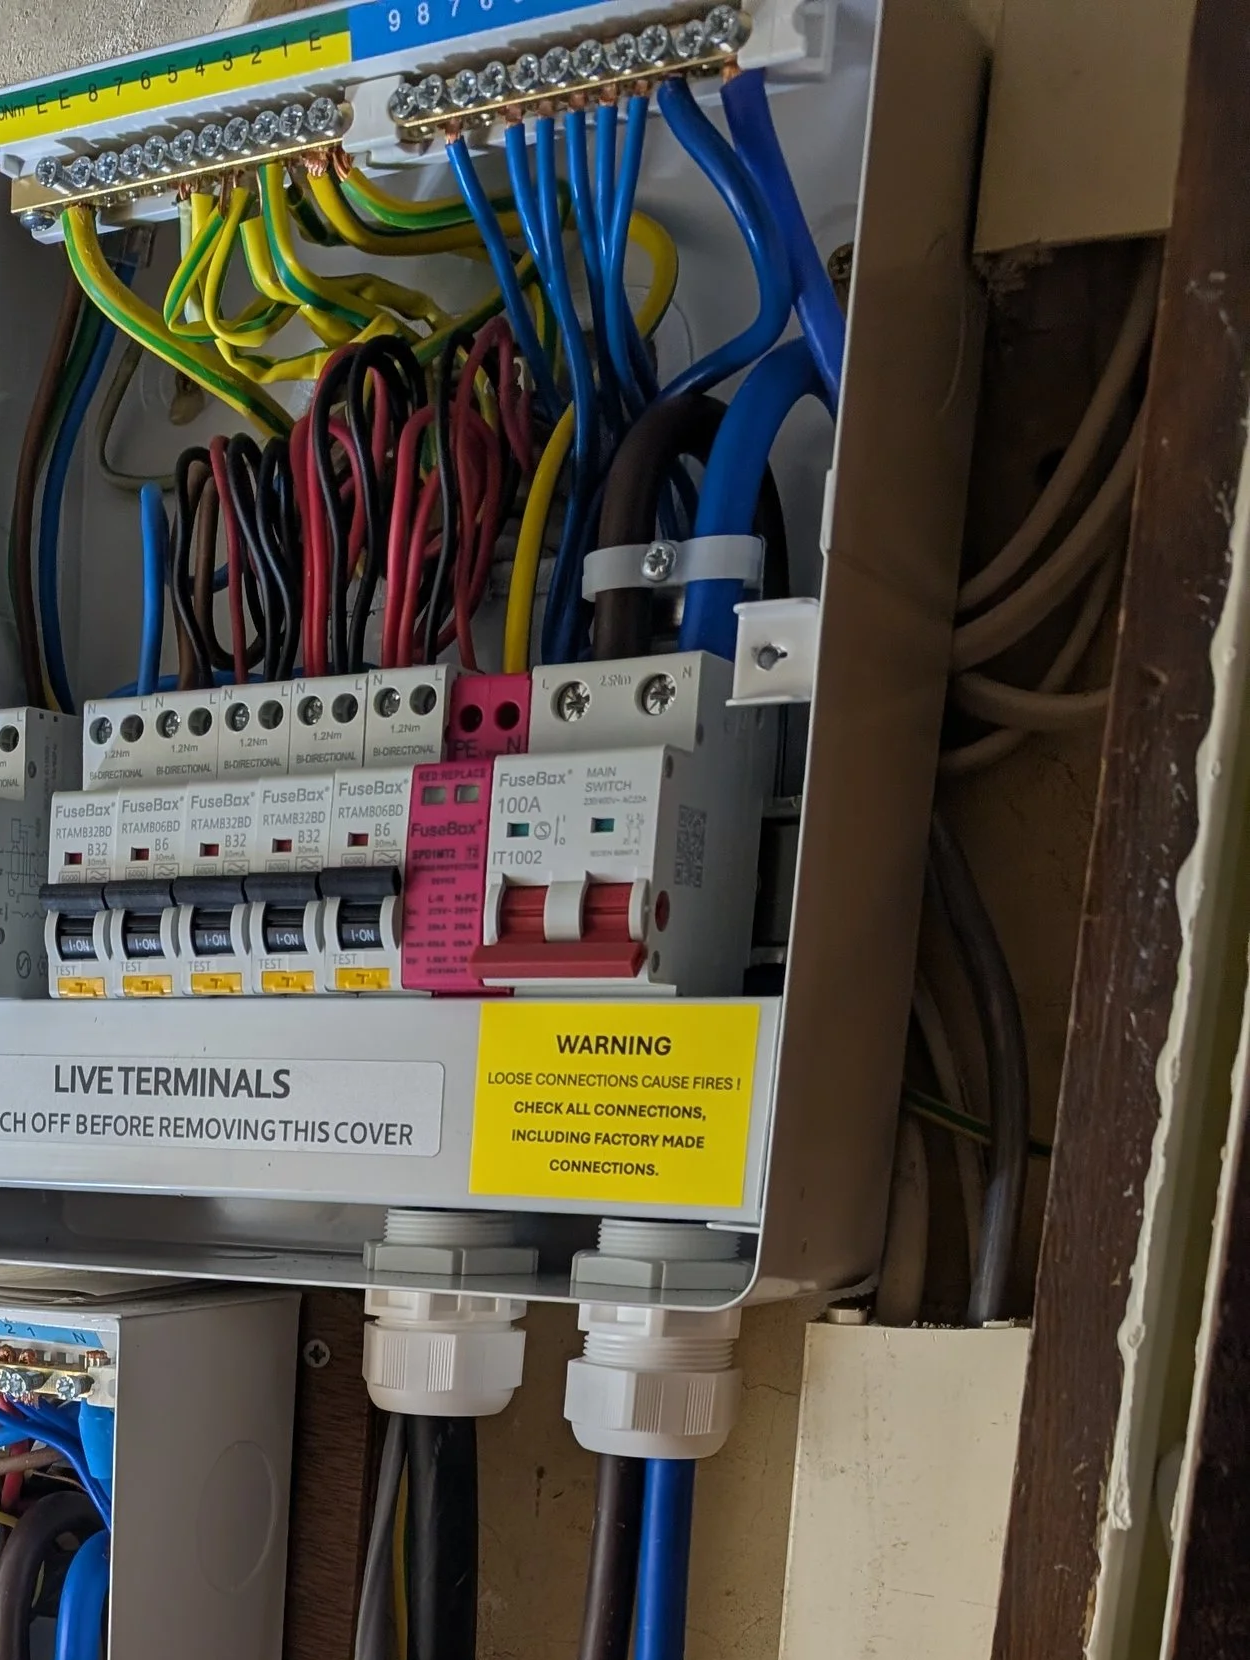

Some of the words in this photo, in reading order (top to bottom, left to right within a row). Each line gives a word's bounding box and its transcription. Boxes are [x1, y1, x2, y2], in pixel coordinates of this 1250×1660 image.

[389, 10, 399, 31] 9
[417, 4, 429, 24] 8
[37, 96, 48, 114] E
[59, 89, 70, 110] E
[88, 83, 99, 102] 8
[114, 76, 124, 96] 7
[141, 71, 151, 90] 6
[168, 65, 178, 83] 5
[195, 59, 205, 76] 4
[223, 52, 233, 70] 3
[251, 46, 261, 65] 2
[282, 38, 288, 56] 1
[310, 31, 321, 51] E
[374, 675, 382, 686] N
[435, 670, 442, 680] L
[224, 690, 233, 700] N
[282, 685, 288, 696] L
[296, 683, 305, 693] N
[356, 680, 362, 690] L
[88, 704, 96, 714] N
[141, 700, 147, 711] L
[155, 697, 164, 708] N
[209, 693, 216, 704] L
[17, 712, 23, 721] L
[391, 724, 420, 733] 1.2Nm
[240, 738, 267, 747] 1.2Nm
[313, 731, 342, 741] 1.2Nm
[171, 743, 198, 752] 1.2Nm
[373, 745, 435, 756] BI-DIRECTIONAL
[104, 751, 130, 759] 1.2Nm
[296, 752, 356, 764] BI-DIRECTIONAL
[156, 763, 212, 776] BI-DIRECTIONAL
[224, 757, 281, 770] BI-DIRECTIONAL
[89, 768, 143, 781] BI-DIRECTIONAL
[587, 767, 616, 778] MAIN
[585, 781, 632, 792] SWITCH
[338, 804, 403, 818] RTAMB06BD
[498, 797, 541, 814] 100A
[191, 816, 251, 830] RTAMB32BD
[263, 811, 325, 825] RTAMB32BD
[56, 826, 112, 839] RTAMB32BD
[122, 820, 180, 834] RTAMB06BD
[375, 823, 390, 836] B6
[225, 834, 246, 847] B32
[298, 829, 320, 843] B32
[88, 843, 107, 856] B32
[155, 838, 169, 851] B6
[492, 851, 542, 865] IT1002
[259, 959, 281, 969] TEST
[332, 954, 356, 965] TEST
[55, 966, 76, 976] TEST
[121, 962, 142, 972] TEST
[188, 961, 210, 972] TEST
[556, 1035, 672, 1056] WARNING
[54, 1065, 114, 1095] LIVE
[118, 1067, 290, 1099] TERMINALS
[488, 1072, 533, 1085] LOOSE
[536, 1073, 638, 1089] CONNECTIONS
[641, 1076, 689, 1089] CAUSE
[693, 1077, 733, 1090] FIRES
[514, 1101, 563, 1115] CHECK
[566, 1103, 590, 1115] ALL
[594, 1104, 706, 1121] CONNECTIONS,
[32, 1112, 70, 1134] OFF
[76, 1114, 154, 1137] BEFORE
[159, 1117, 277, 1142] REMOVING
[278, 1120, 330, 1143] THIS
[334, 1121, 413, 1146] COVER
[511, 1129, 591, 1144] INCLUDING
[594, 1133, 658, 1147] FACTORY
[661, 1135, 704, 1149] MADE
[549, 1159, 659, 1176] CONNECTIONS.
[4, 1324, 16, 1335] 2
[27, 1326, 35, 1337] 1
[72, 1331, 86, 1344] N
